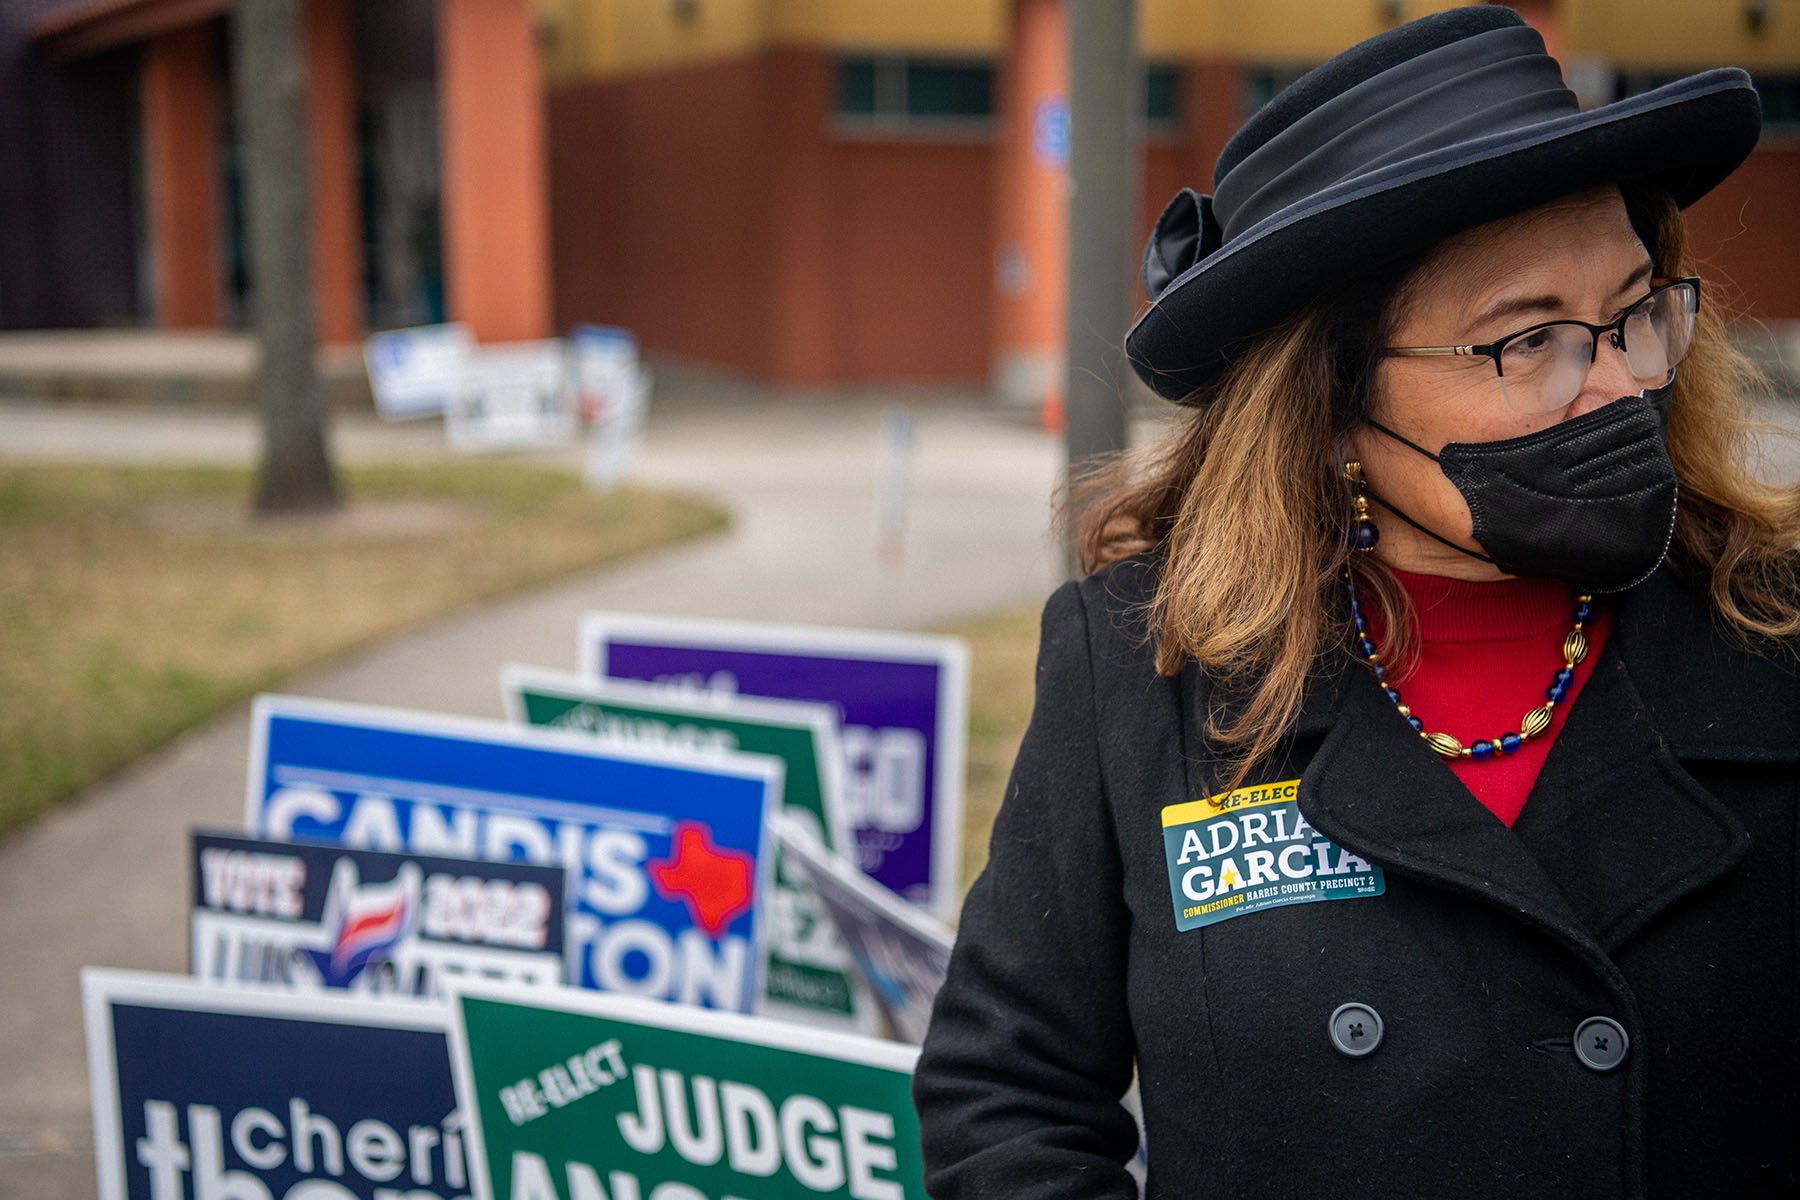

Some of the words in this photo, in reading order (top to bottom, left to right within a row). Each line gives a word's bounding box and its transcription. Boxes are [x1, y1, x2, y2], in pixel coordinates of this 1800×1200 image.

[1220, 785, 1299, 810] RE-ELEC
[202, 849, 307, 920] VOTE
[424, 872, 551, 950] 2022
[1181, 841, 1371, 901] GARCIA
[1183, 894, 1245, 919] COMMISSIONER
[1246, 886, 1279, 902] HARRIS
[1281, 881, 1317, 894] COUNTY
[1320, 877, 1366, 890] PRECINCT
[1368, 876, 1375, 886] 2
[498, 1039, 627, 1126] RE-ELECT
[616, 1064, 905, 1200] JUDGE
